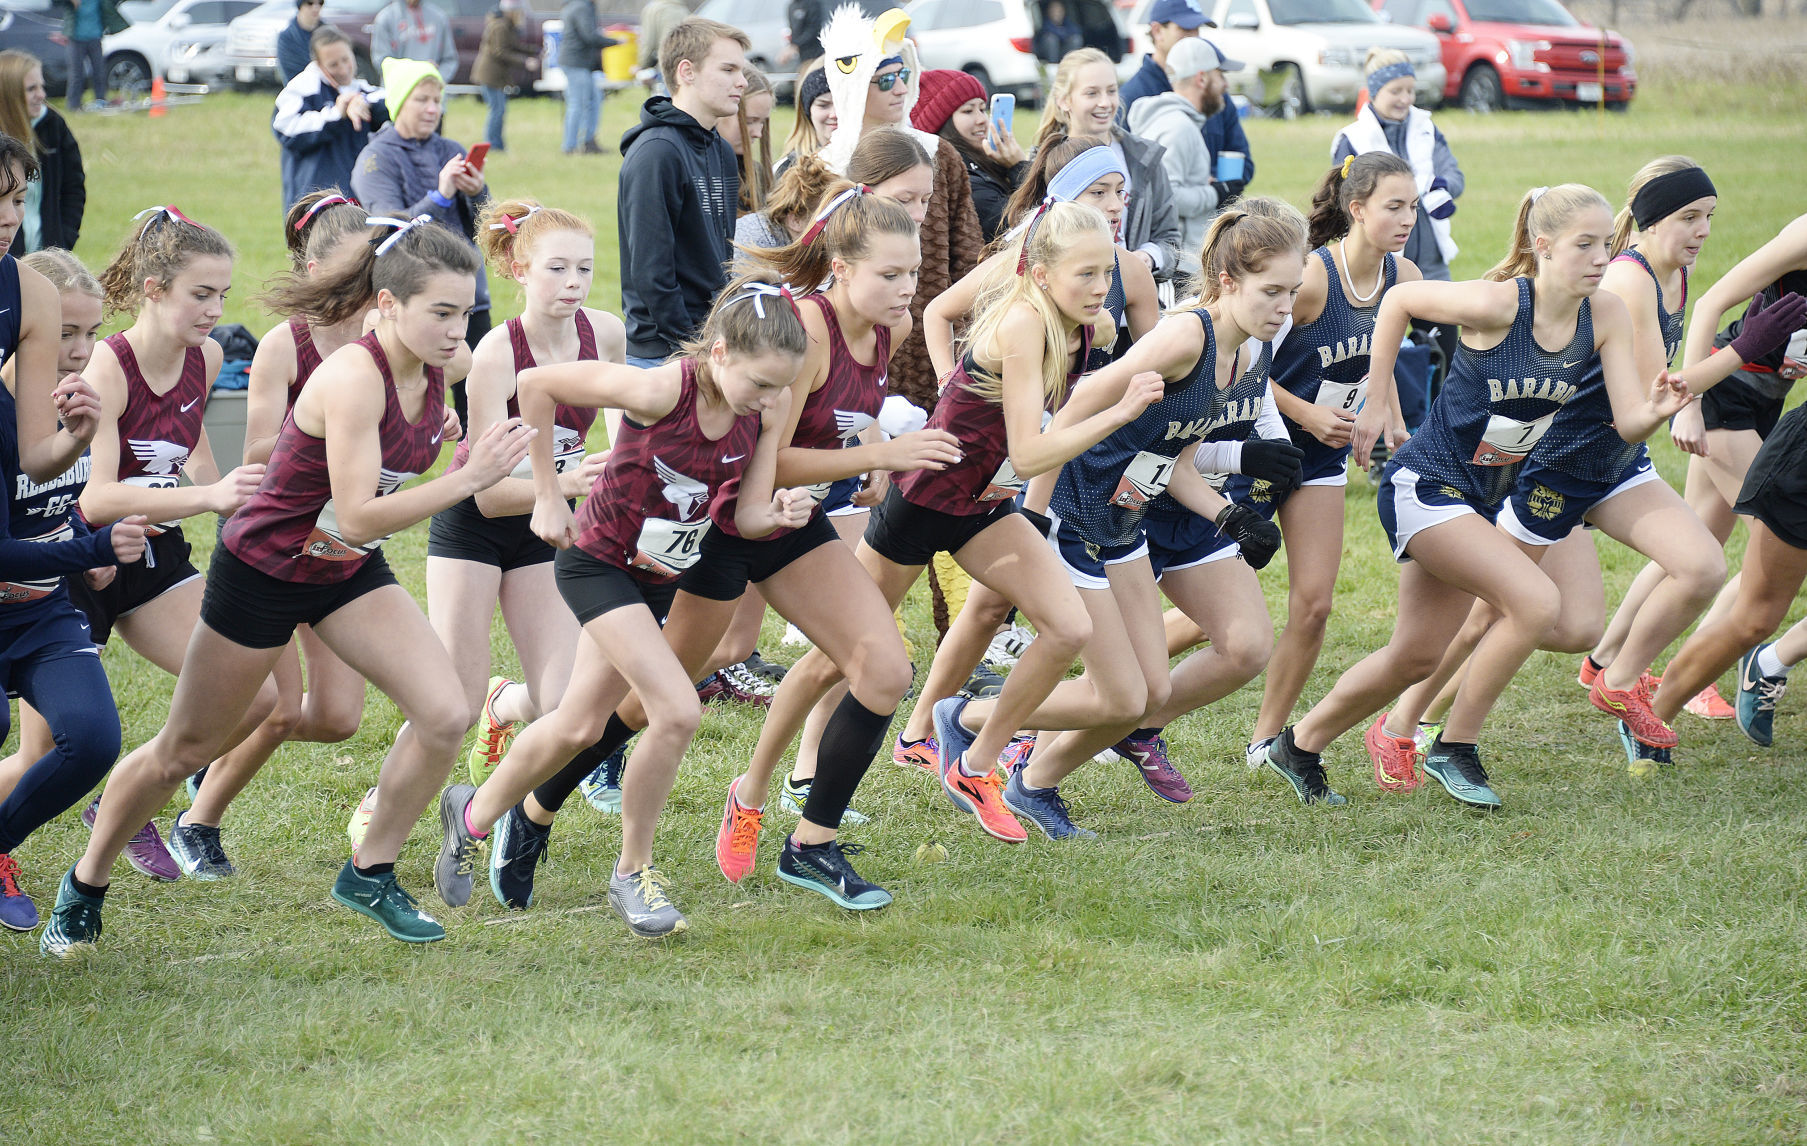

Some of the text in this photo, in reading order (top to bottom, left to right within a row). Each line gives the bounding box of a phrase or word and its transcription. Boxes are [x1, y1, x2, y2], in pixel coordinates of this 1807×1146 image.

[1317, 334, 1371, 368] BARA
[1342, 388, 1358, 409] 9
[1516, 424, 1536, 445] 7
[664, 529, 699, 555] 76
